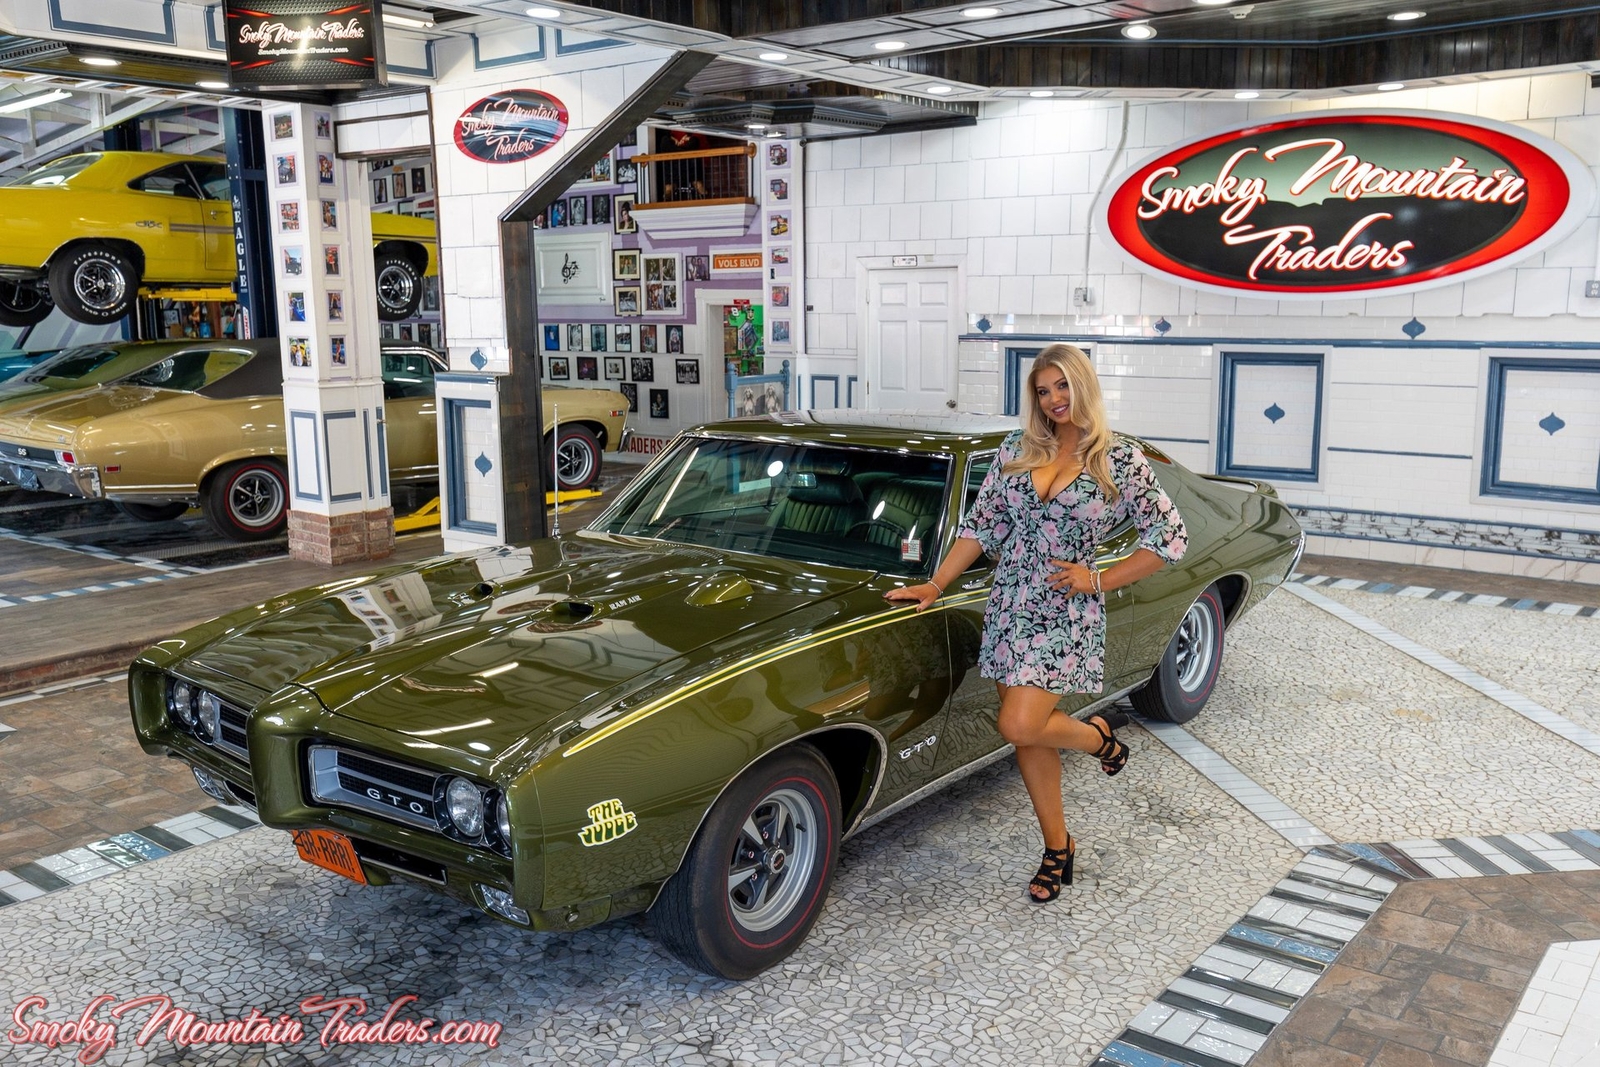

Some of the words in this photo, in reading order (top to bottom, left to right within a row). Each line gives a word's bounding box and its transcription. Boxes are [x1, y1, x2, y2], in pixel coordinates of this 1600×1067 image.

[239, 21, 272, 48] Smoky
[321, 18, 365, 42] Traders
[257, 47, 349, 56] SmokyMouninTraders.com
[461, 102, 497, 137] Smoky
[493, 97, 560, 123] Mountain
[486, 127, 536, 161] Traders
[1137, 146, 1268, 226] Smoky
[1264, 137, 1528, 206] Mountain
[234, 210, 248, 287] EAGLE
[1223, 211, 1415, 281] Traders
[718, 259, 738, 268] VOLS
[740, 258, 760, 267] BLVD
[17, 447, 27, 456] SS
[608, 599, 628, 610] RAM
[627, 594, 643, 605] AIR
[898, 735, 937, 759] GTO
[366, 787, 424, 814] GTO
[587, 798, 623, 824] THE
[577, 811, 639, 847] JUDGE
